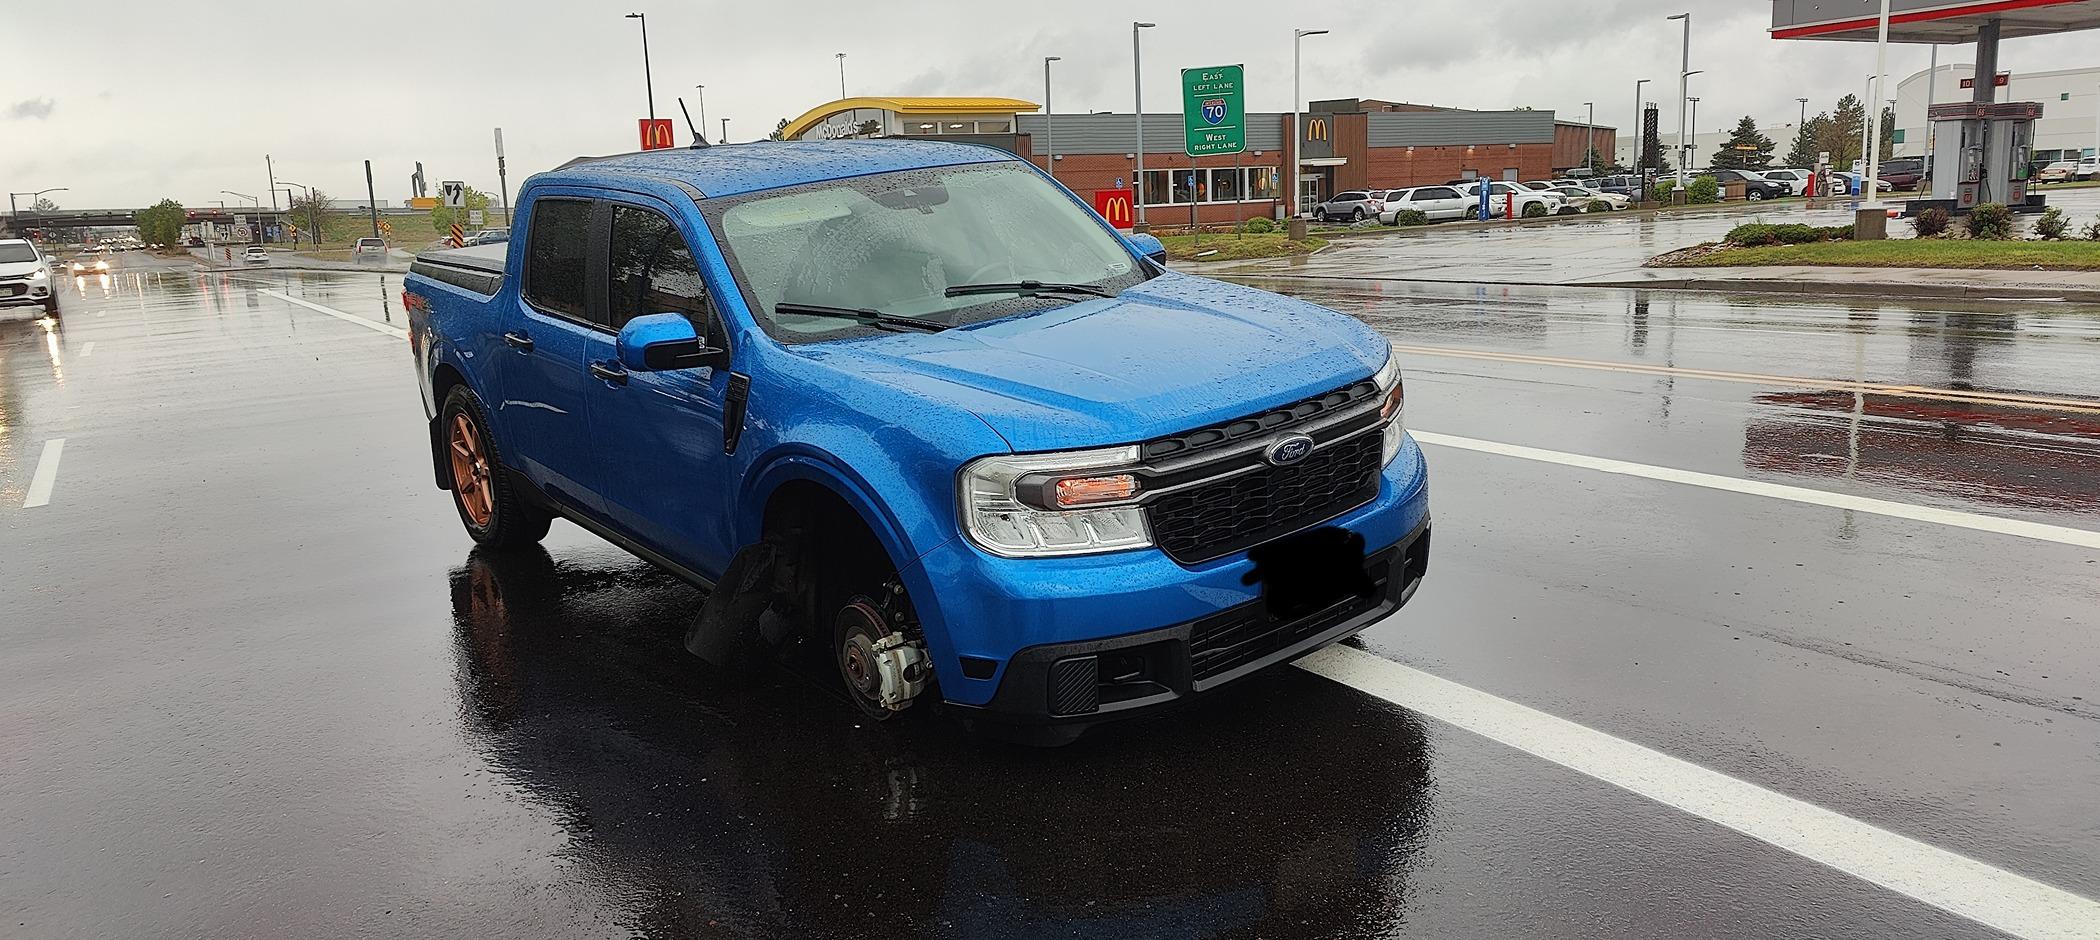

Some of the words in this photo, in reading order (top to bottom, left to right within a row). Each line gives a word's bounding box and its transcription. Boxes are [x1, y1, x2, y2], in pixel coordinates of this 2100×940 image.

[1213, 82, 1234, 90] LANE
[1206, 105, 1223, 118] 70
[1194, 143, 1215, 151] RIGHT
[1281, 442, 1306, 461] Ford
